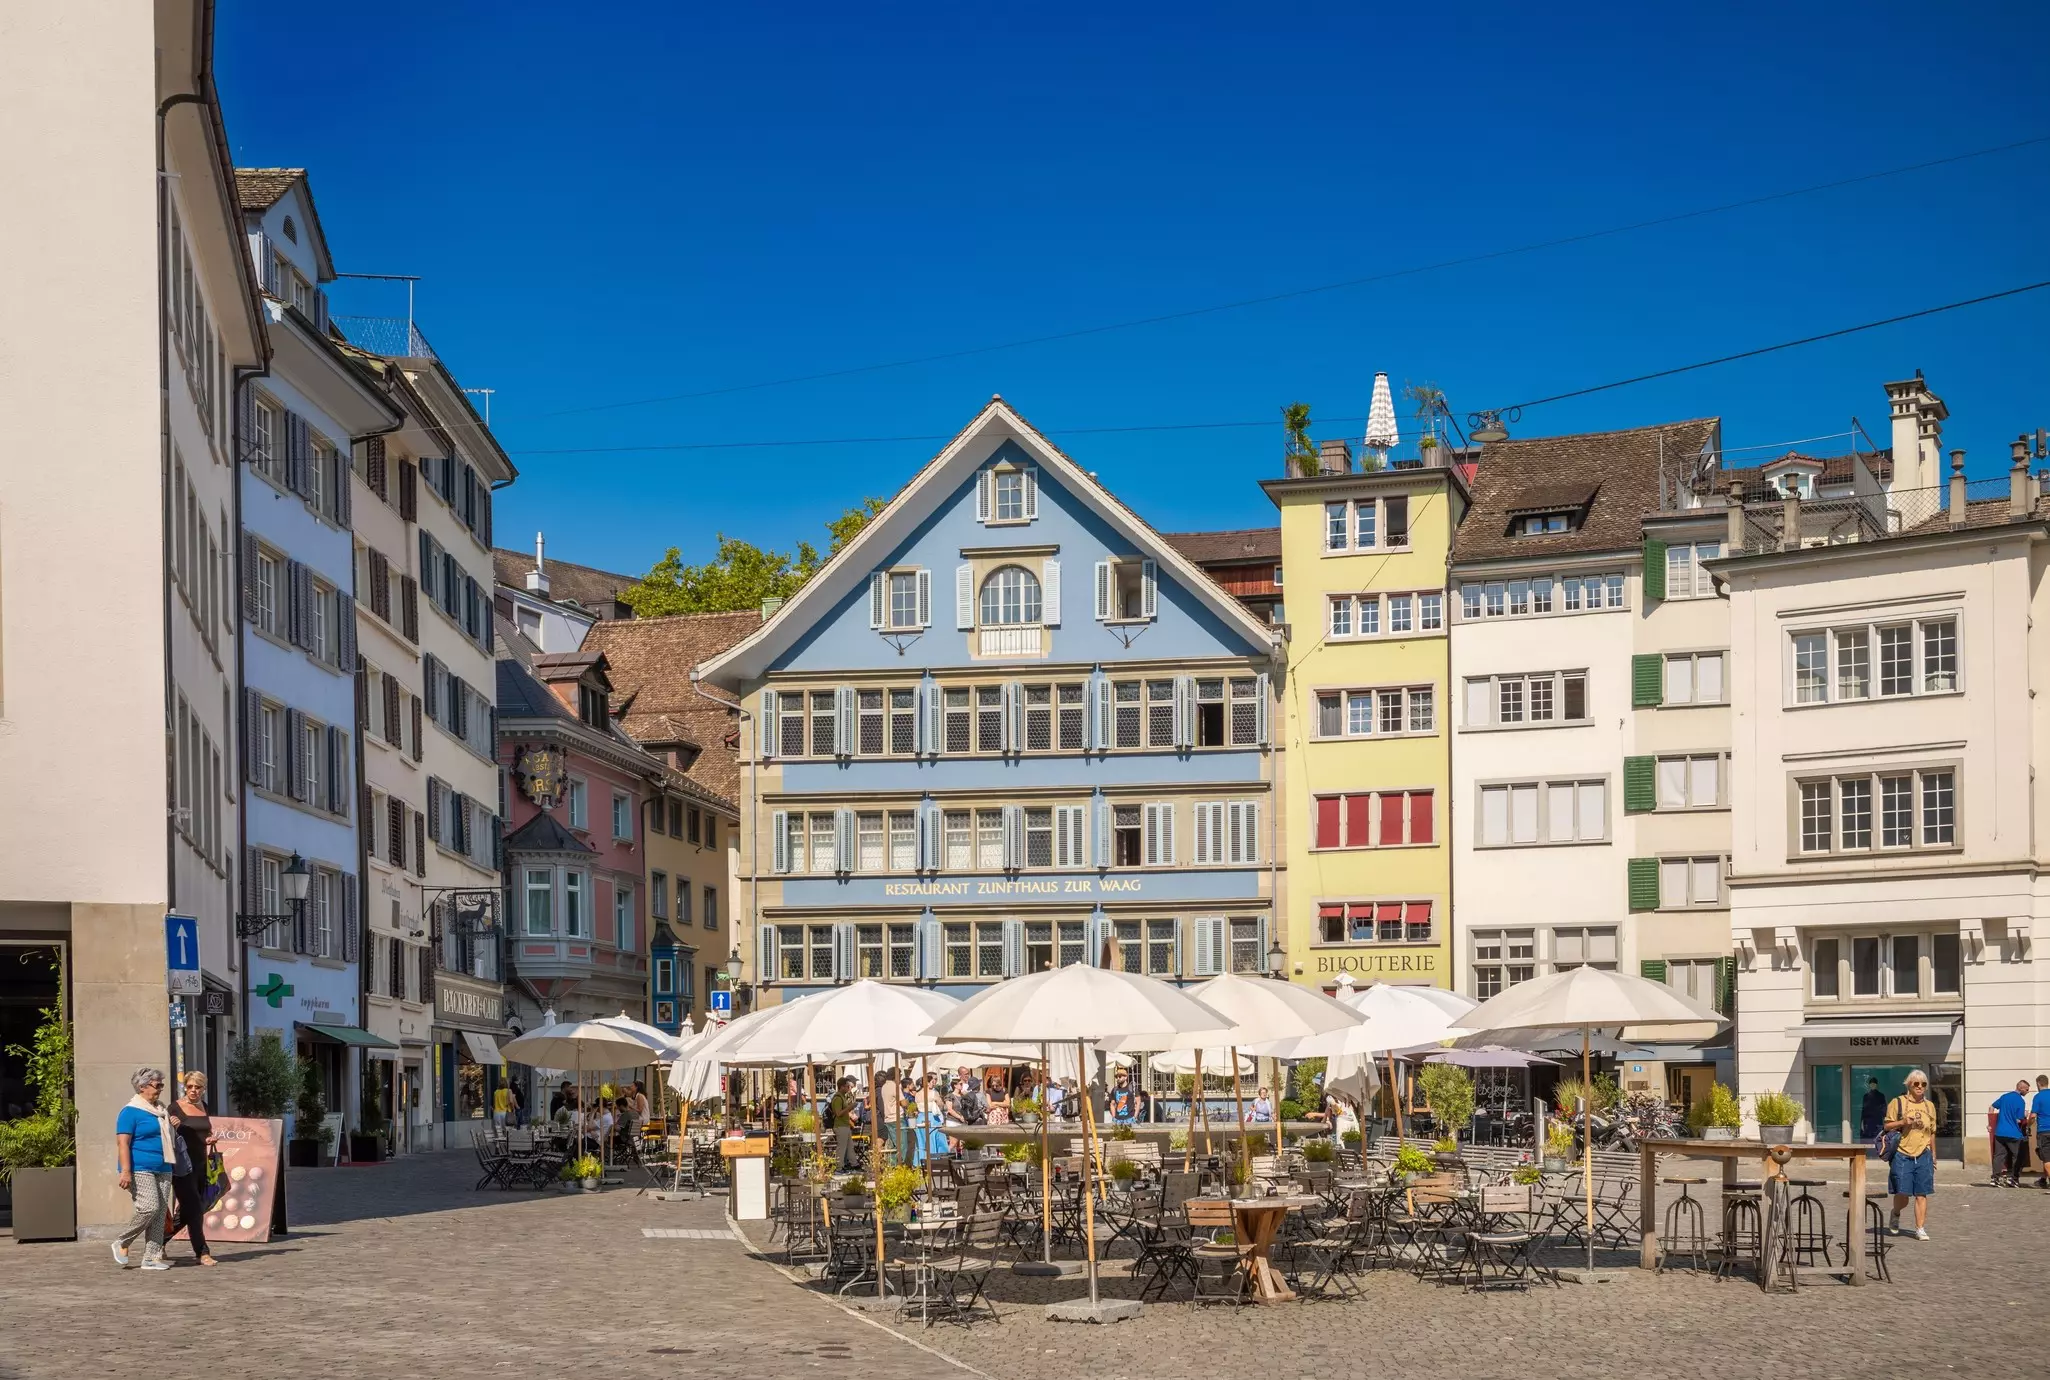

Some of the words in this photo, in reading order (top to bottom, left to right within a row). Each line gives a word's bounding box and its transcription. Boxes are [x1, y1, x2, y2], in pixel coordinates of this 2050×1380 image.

[885, 884, 970, 896] RESTAURANT
[978, 882, 1058, 894] ZUNFTHAUS
[1064, 881, 1092, 893] ZUR
[1099, 880, 1142, 892] WAAG
[1317, 955, 1435, 972] BIJOUTERIE
[1849, 1037, 1879, 1046] ISSEY
[1881, 1036, 1920, 1046] MIYAKE
